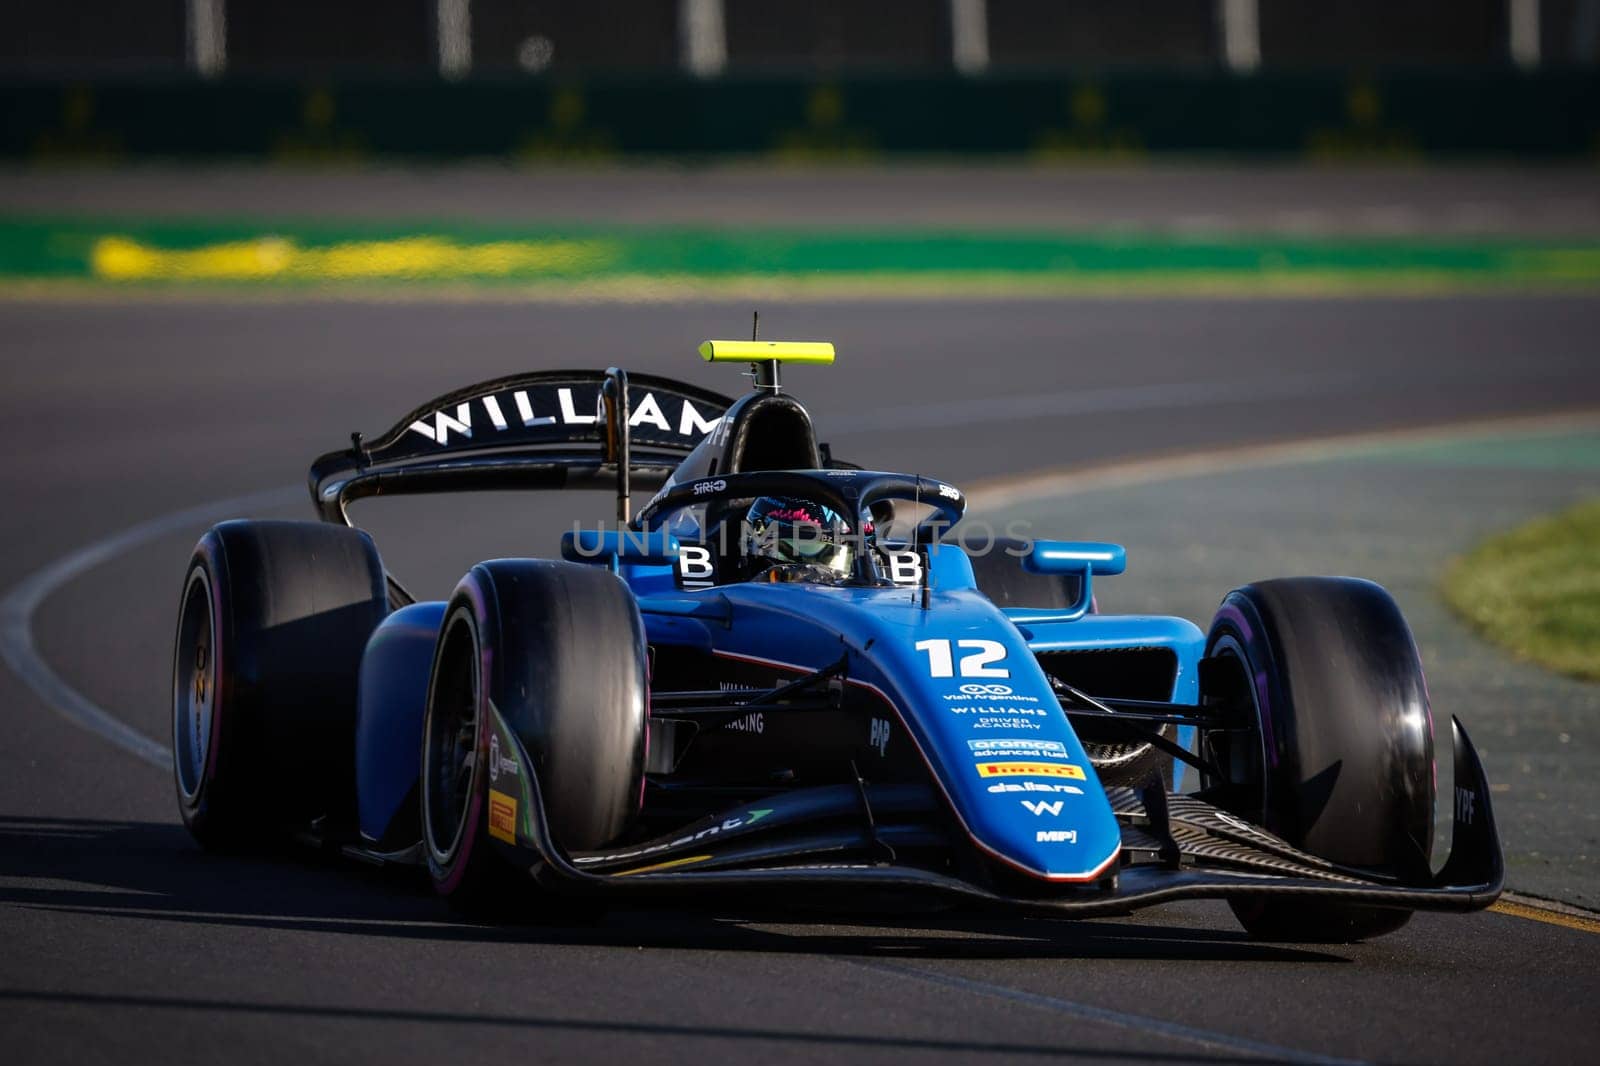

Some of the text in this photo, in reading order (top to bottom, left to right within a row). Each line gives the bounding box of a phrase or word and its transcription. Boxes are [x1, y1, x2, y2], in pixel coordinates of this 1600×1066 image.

[679, 546, 714, 578] B
[888, 551, 923, 582] B
[915, 639, 1010, 678] 12
[943, 693, 1039, 702] Visit Argentina
[950, 706, 1048, 716] WILLIAMS
[724, 712, 764, 734] ACING
[973, 722, 1041, 730] ACADEMY
[974, 740, 1060, 750] aramco
[1042, 750, 1069, 759] fuel
[1455, 785, 1476, 825] YPF
